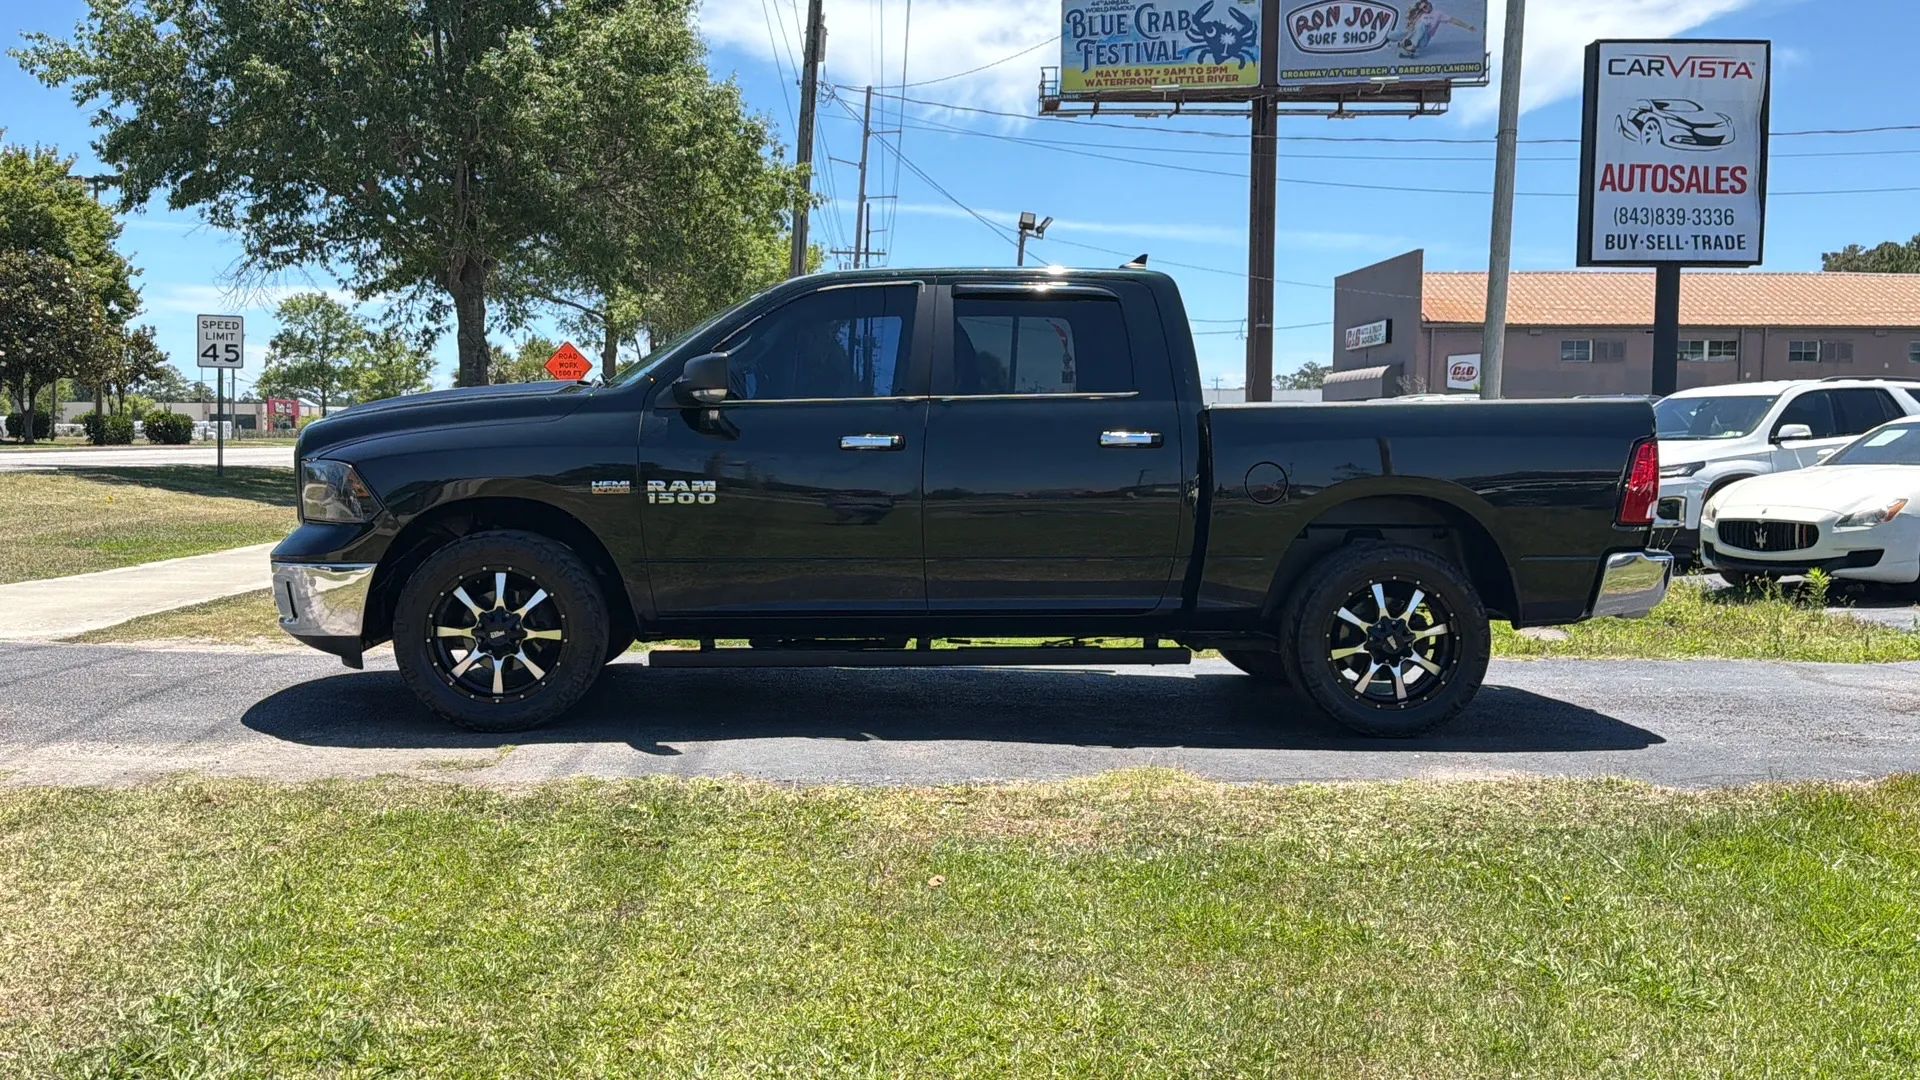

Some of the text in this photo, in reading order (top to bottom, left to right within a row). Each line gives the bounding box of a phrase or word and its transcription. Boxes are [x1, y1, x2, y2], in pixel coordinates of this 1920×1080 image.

[1066, 3, 1192, 40] BLUE CRAB
[1295, 5, 1391, 36] RON JON
[1307, 30, 1377, 46] SURF SHOP
[1076, 39, 1184, 73] FESTIVAL
[1095, 66, 1228, 78] MAY 16 & 17 9AM TO 5PM
[1281, 64, 1481, 79] BROADWAY AT THE BEACH & BAREFOOT LANDING
[1608, 55, 1753, 79] CARVISTA
[1085, 74, 1239, 87] WATERFRONT LITTLE RIVER
[1599, 163, 1747, 194] AUTOSALES
[1613, 206, 1735, 227] (843)839-3336
[202, 320, 240, 330] SPEED
[205, 332, 235, 340] LIMIT
[201, 343, 240, 362] 45
[591, 480, 630, 488] HEMI
[647, 480, 717, 492] RAM
[647, 492, 717, 504] 1500
